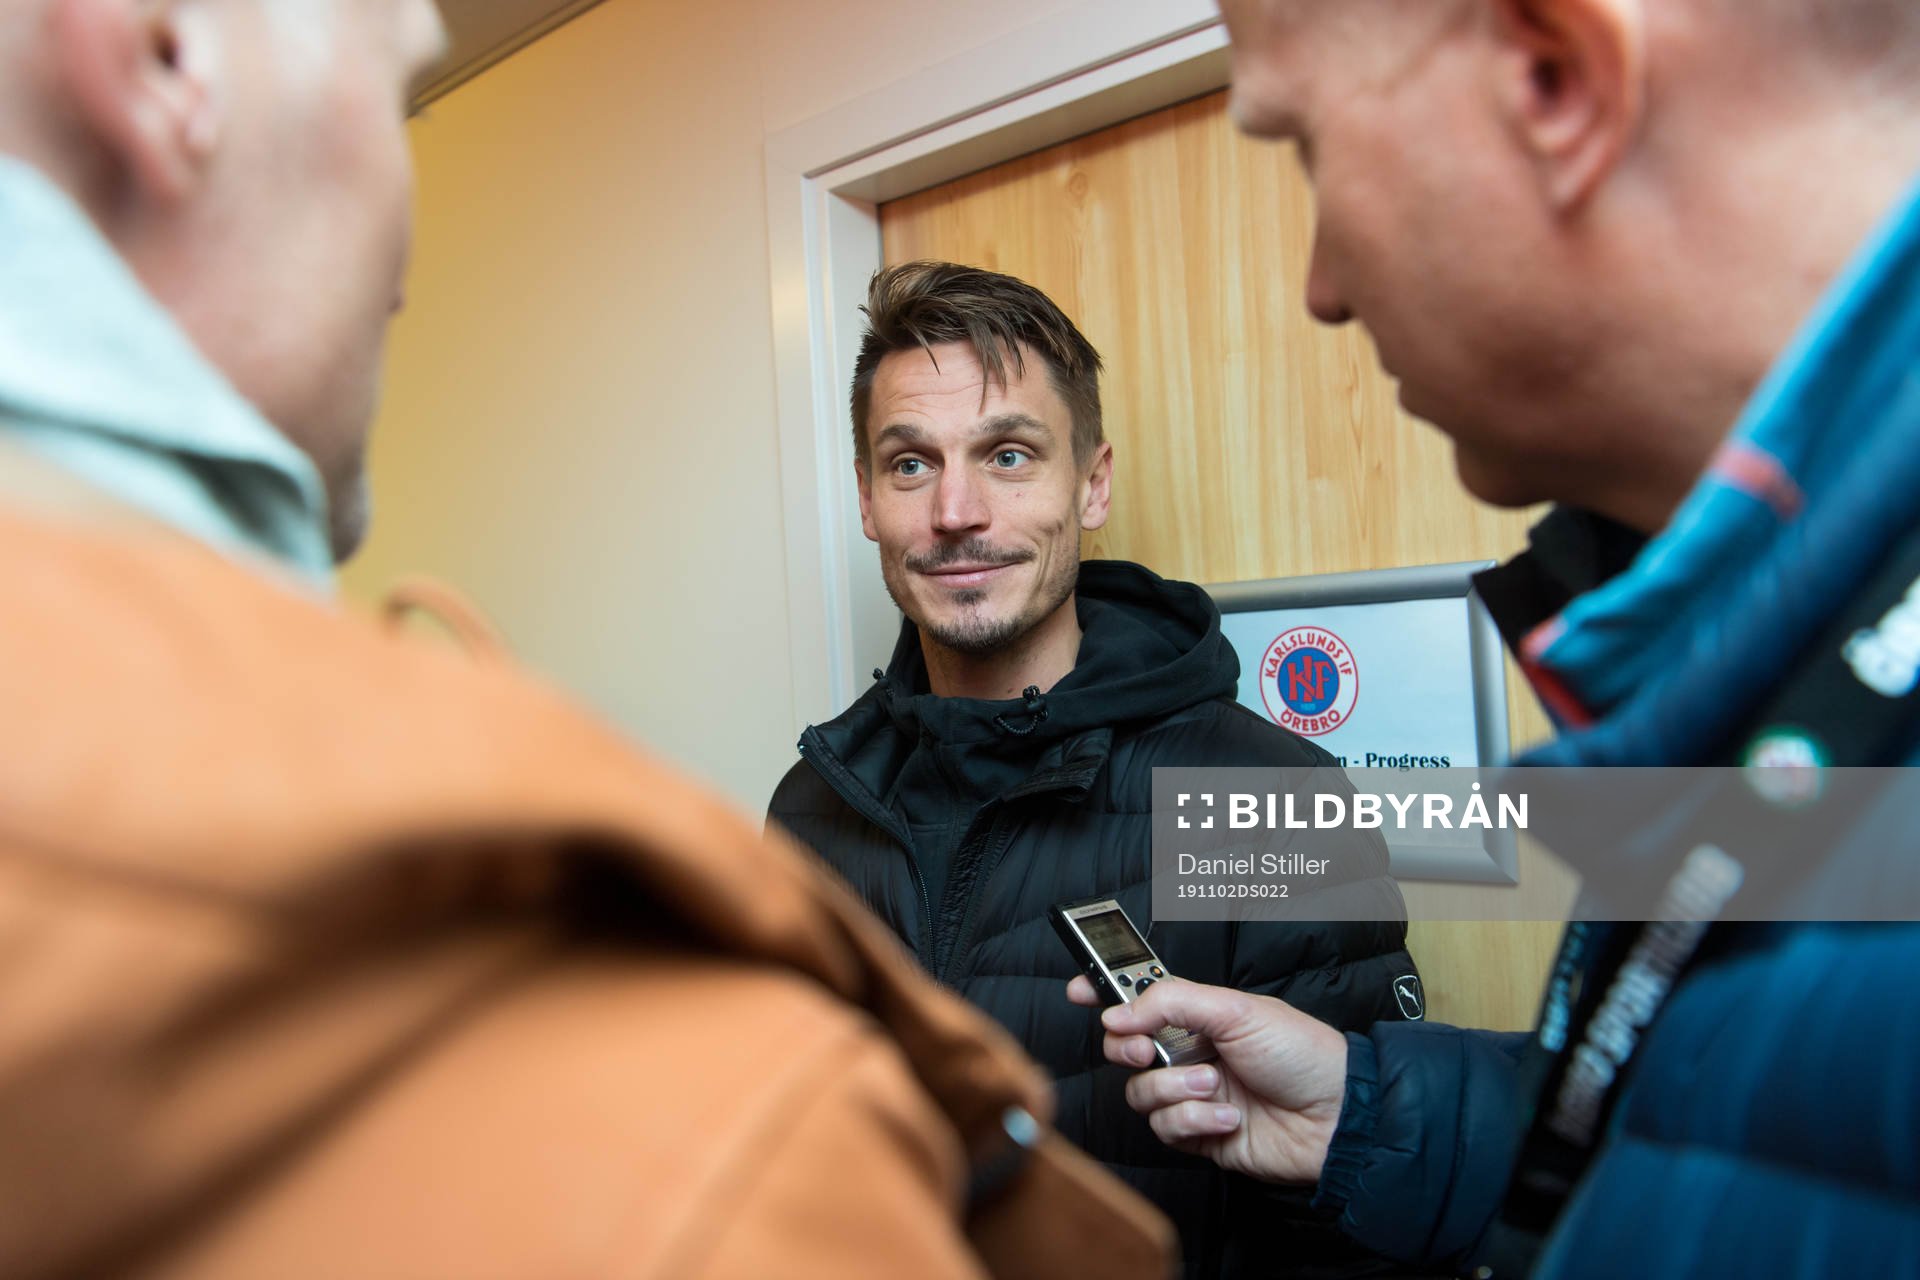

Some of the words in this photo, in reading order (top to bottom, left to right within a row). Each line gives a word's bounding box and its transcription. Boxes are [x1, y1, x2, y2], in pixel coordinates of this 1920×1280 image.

[1264, 632, 1344, 679] KARLSLUNDS
[1339, 661, 1353, 675] IF
[1280, 708, 1341, 732] ÖREBRO
[1365, 752, 1451, 772] Progress
